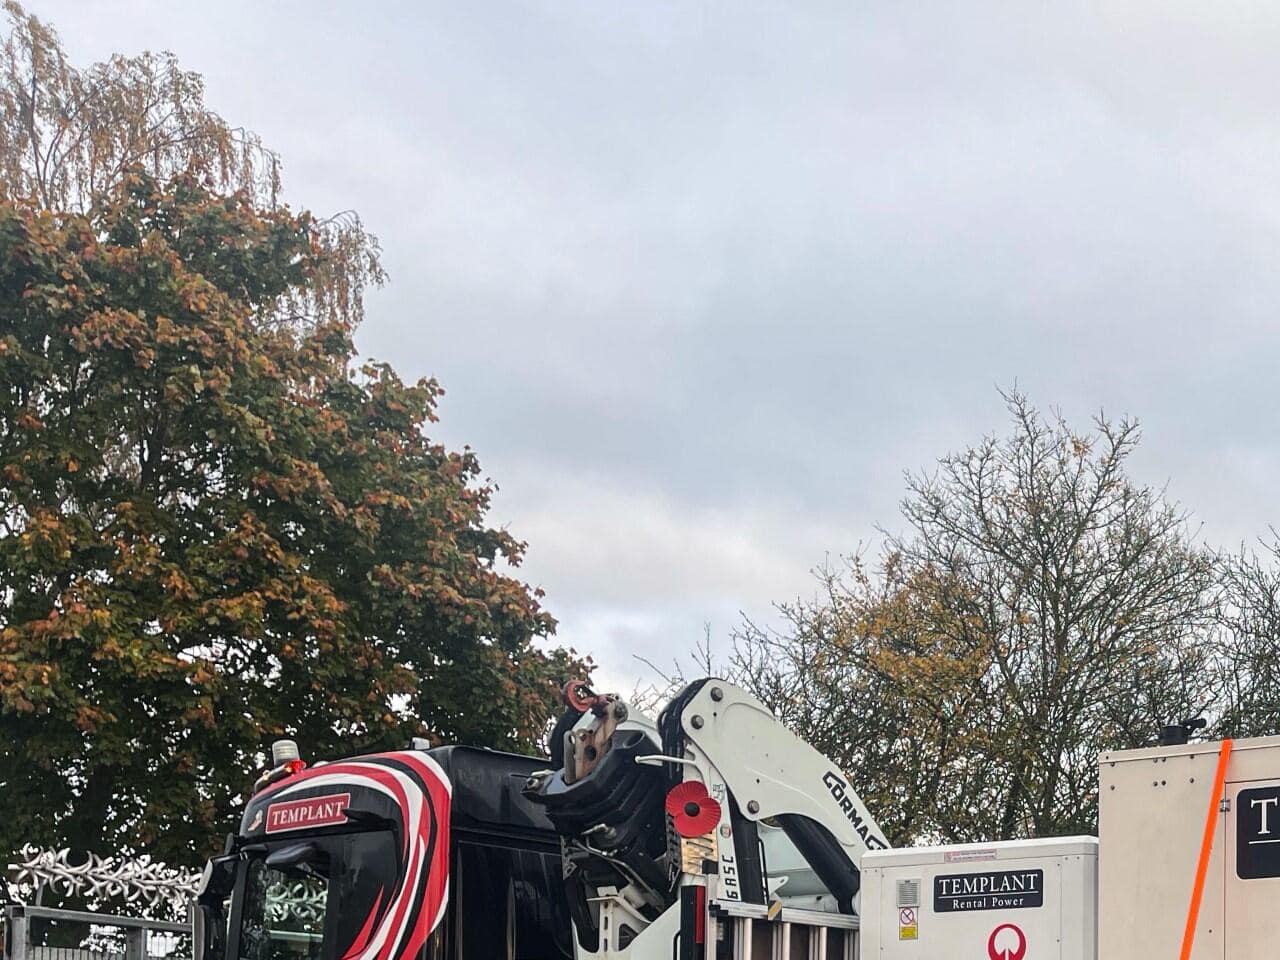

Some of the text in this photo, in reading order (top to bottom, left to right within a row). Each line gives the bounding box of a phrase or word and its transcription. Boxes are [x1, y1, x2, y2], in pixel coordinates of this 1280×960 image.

[272, 801, 344, 826] TEMPLANT
[823, 771, 889, 850] CORMAC
[938, 873, 1038, 895] TEMPLANT
[953, 896, 1024, 910] Rental Power
